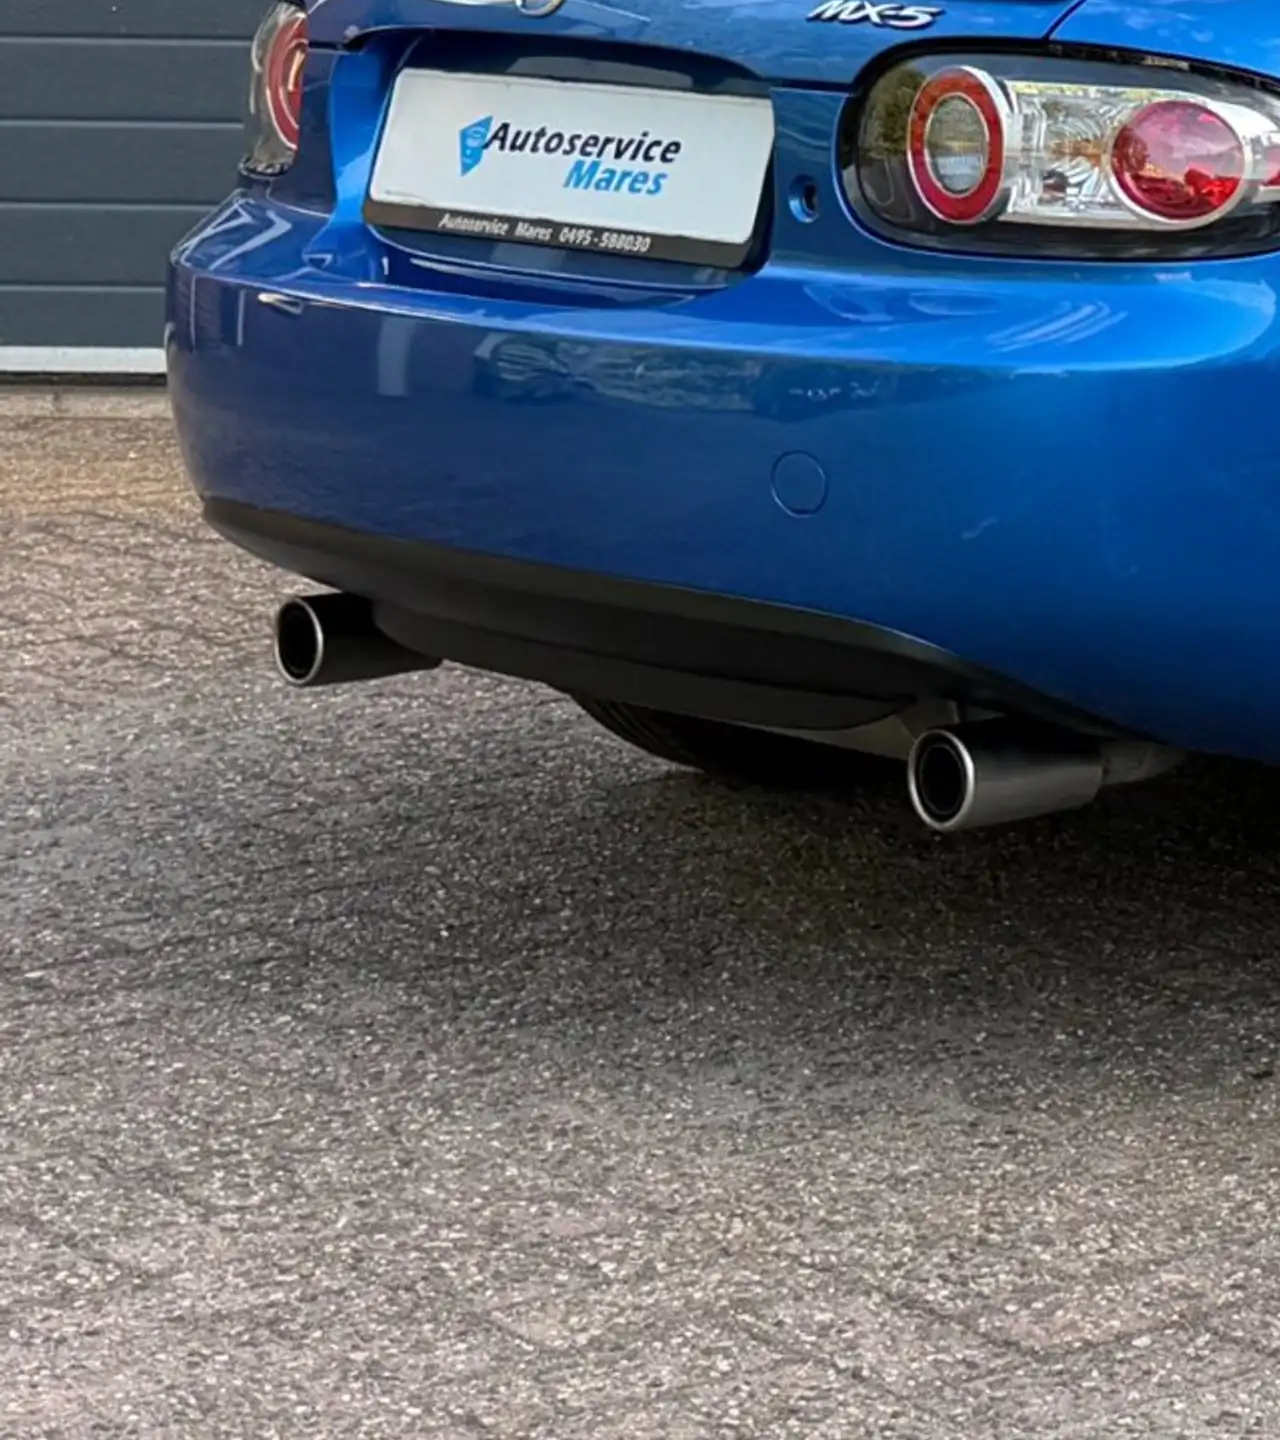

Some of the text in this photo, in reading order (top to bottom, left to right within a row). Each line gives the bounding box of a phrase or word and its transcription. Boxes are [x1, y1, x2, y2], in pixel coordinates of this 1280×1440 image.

[807, 0, 944, 30] MX-5
[481, 122, 682, 164] Autoservice
[563, 160, 668, 195] Mares
[438, 213, 509, 236] Autoservice
[515, 221, 553, 242] Mares
